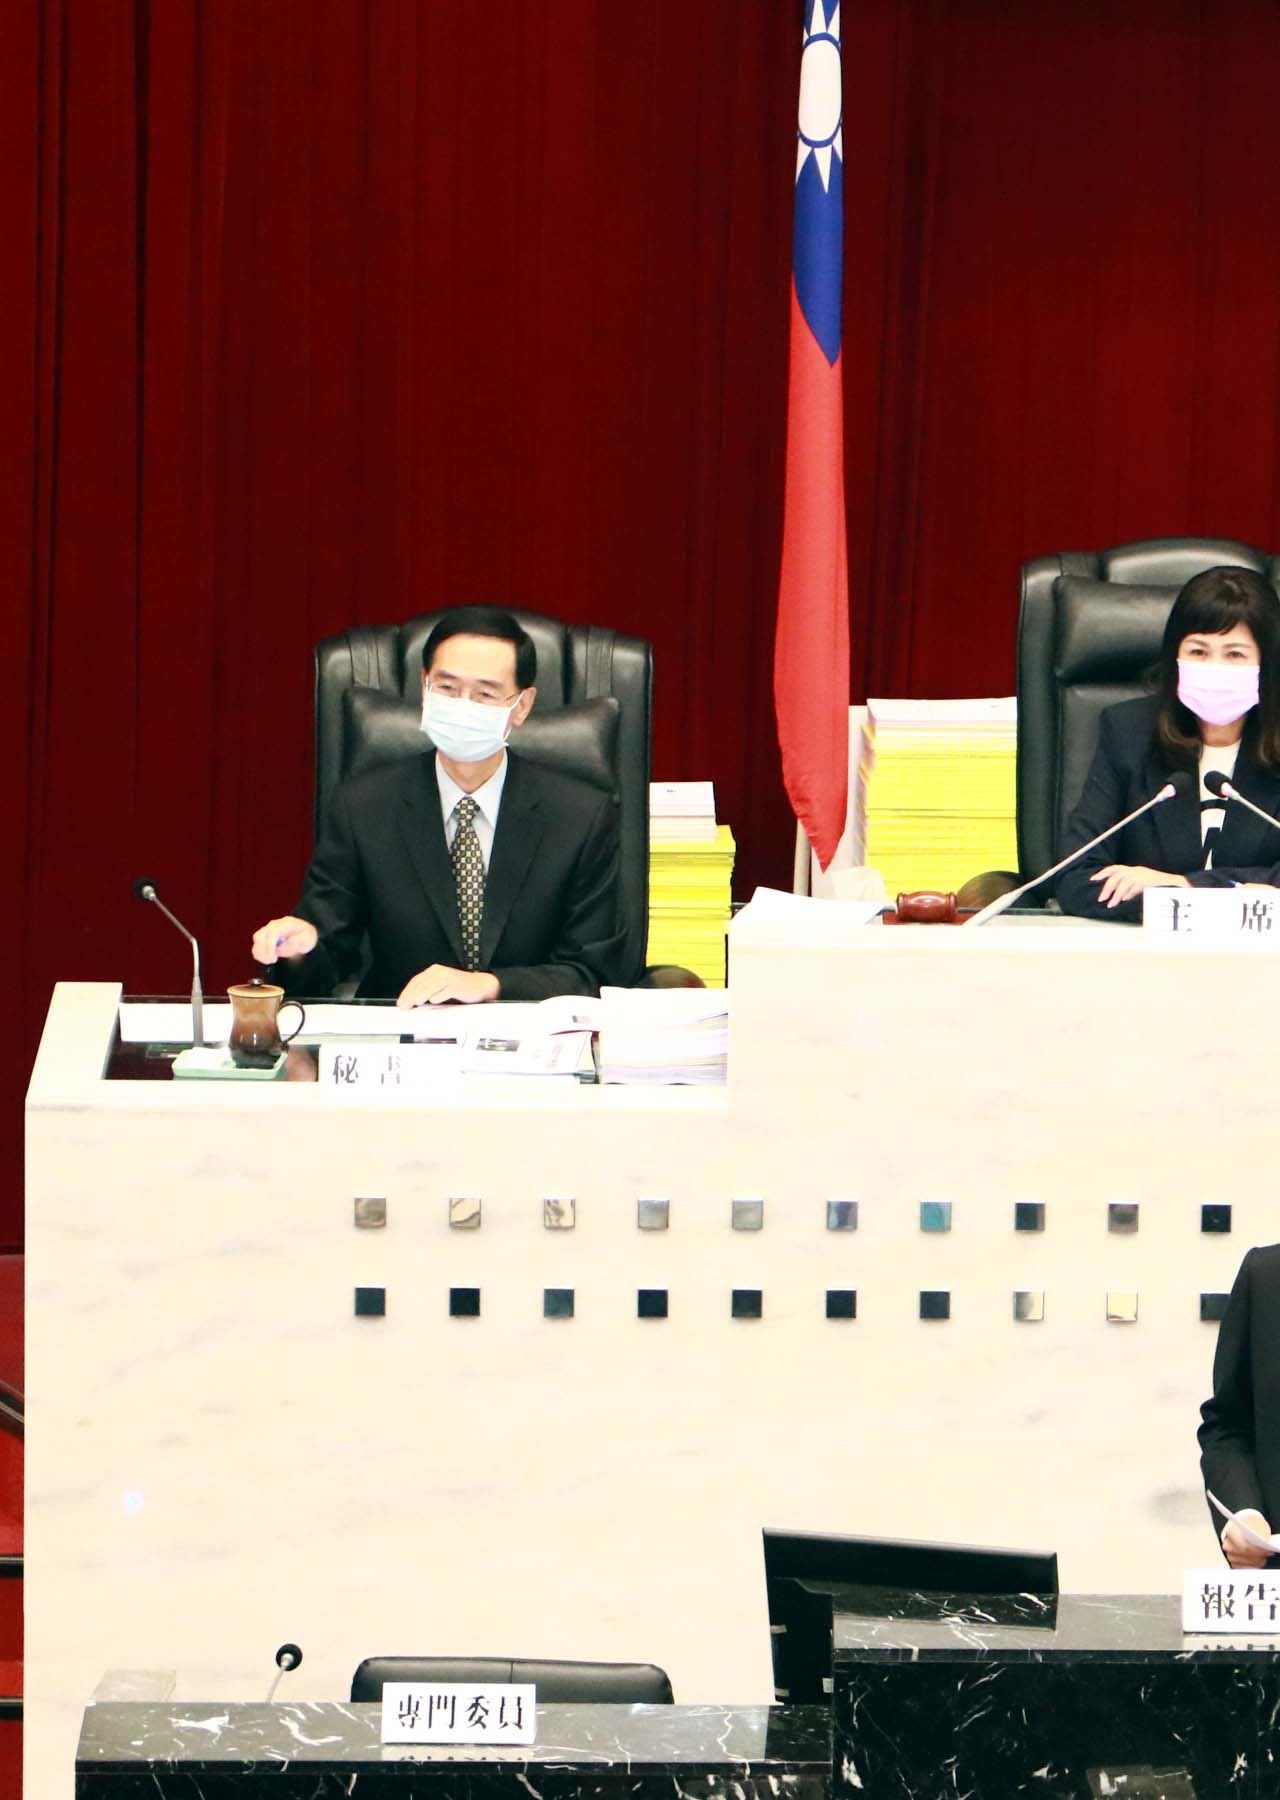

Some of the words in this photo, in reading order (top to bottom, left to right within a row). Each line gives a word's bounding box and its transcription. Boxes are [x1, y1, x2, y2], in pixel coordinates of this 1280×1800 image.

[1159, 897, 1275, 934] 主席
[397, 1693, 524, 1731] 專門委員
